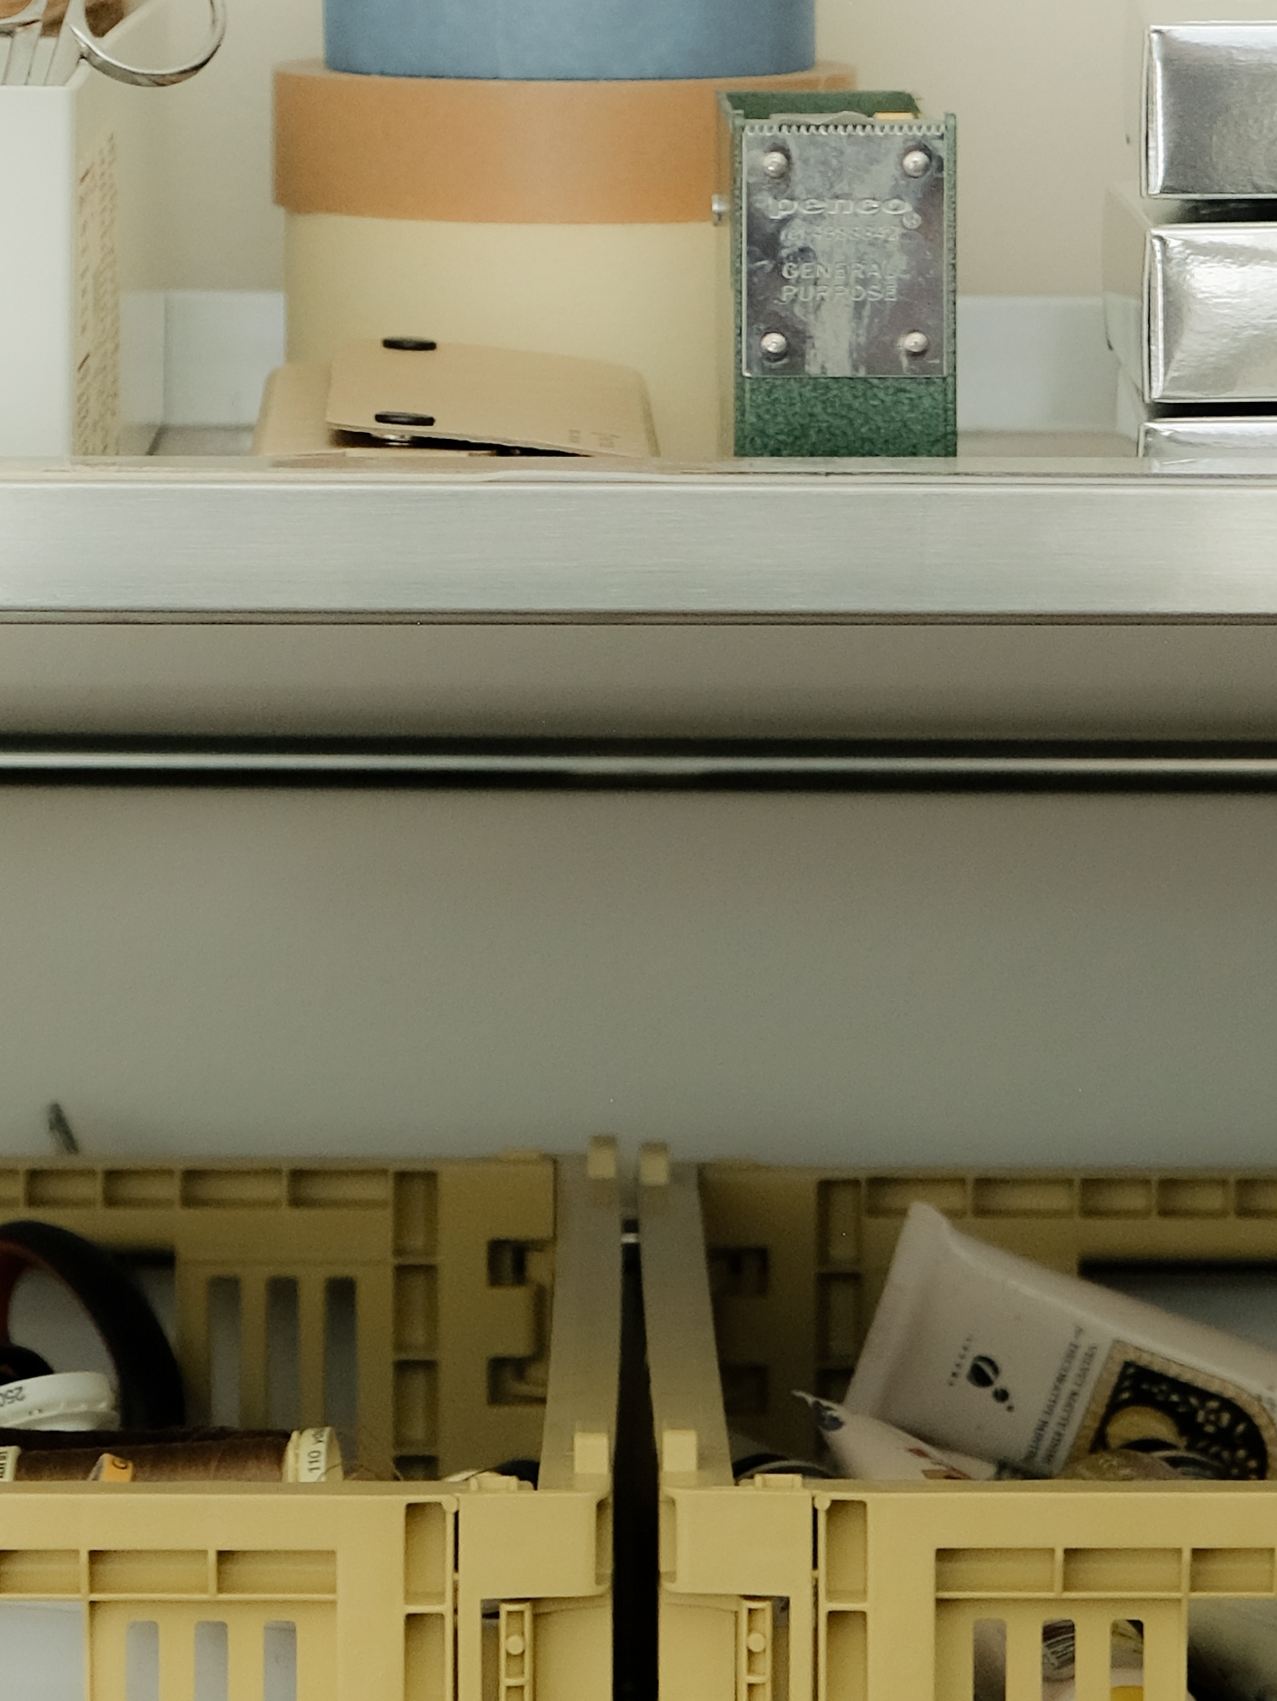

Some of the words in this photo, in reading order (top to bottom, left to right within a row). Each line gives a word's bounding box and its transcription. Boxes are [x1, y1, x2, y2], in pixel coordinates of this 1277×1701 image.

[769, 198, 912, 220] penco
[781, 262, 898, 280] GENERAL
[781, 284, 898, 302] PURPOSE
[307, 1450, 322, 1473] 110
